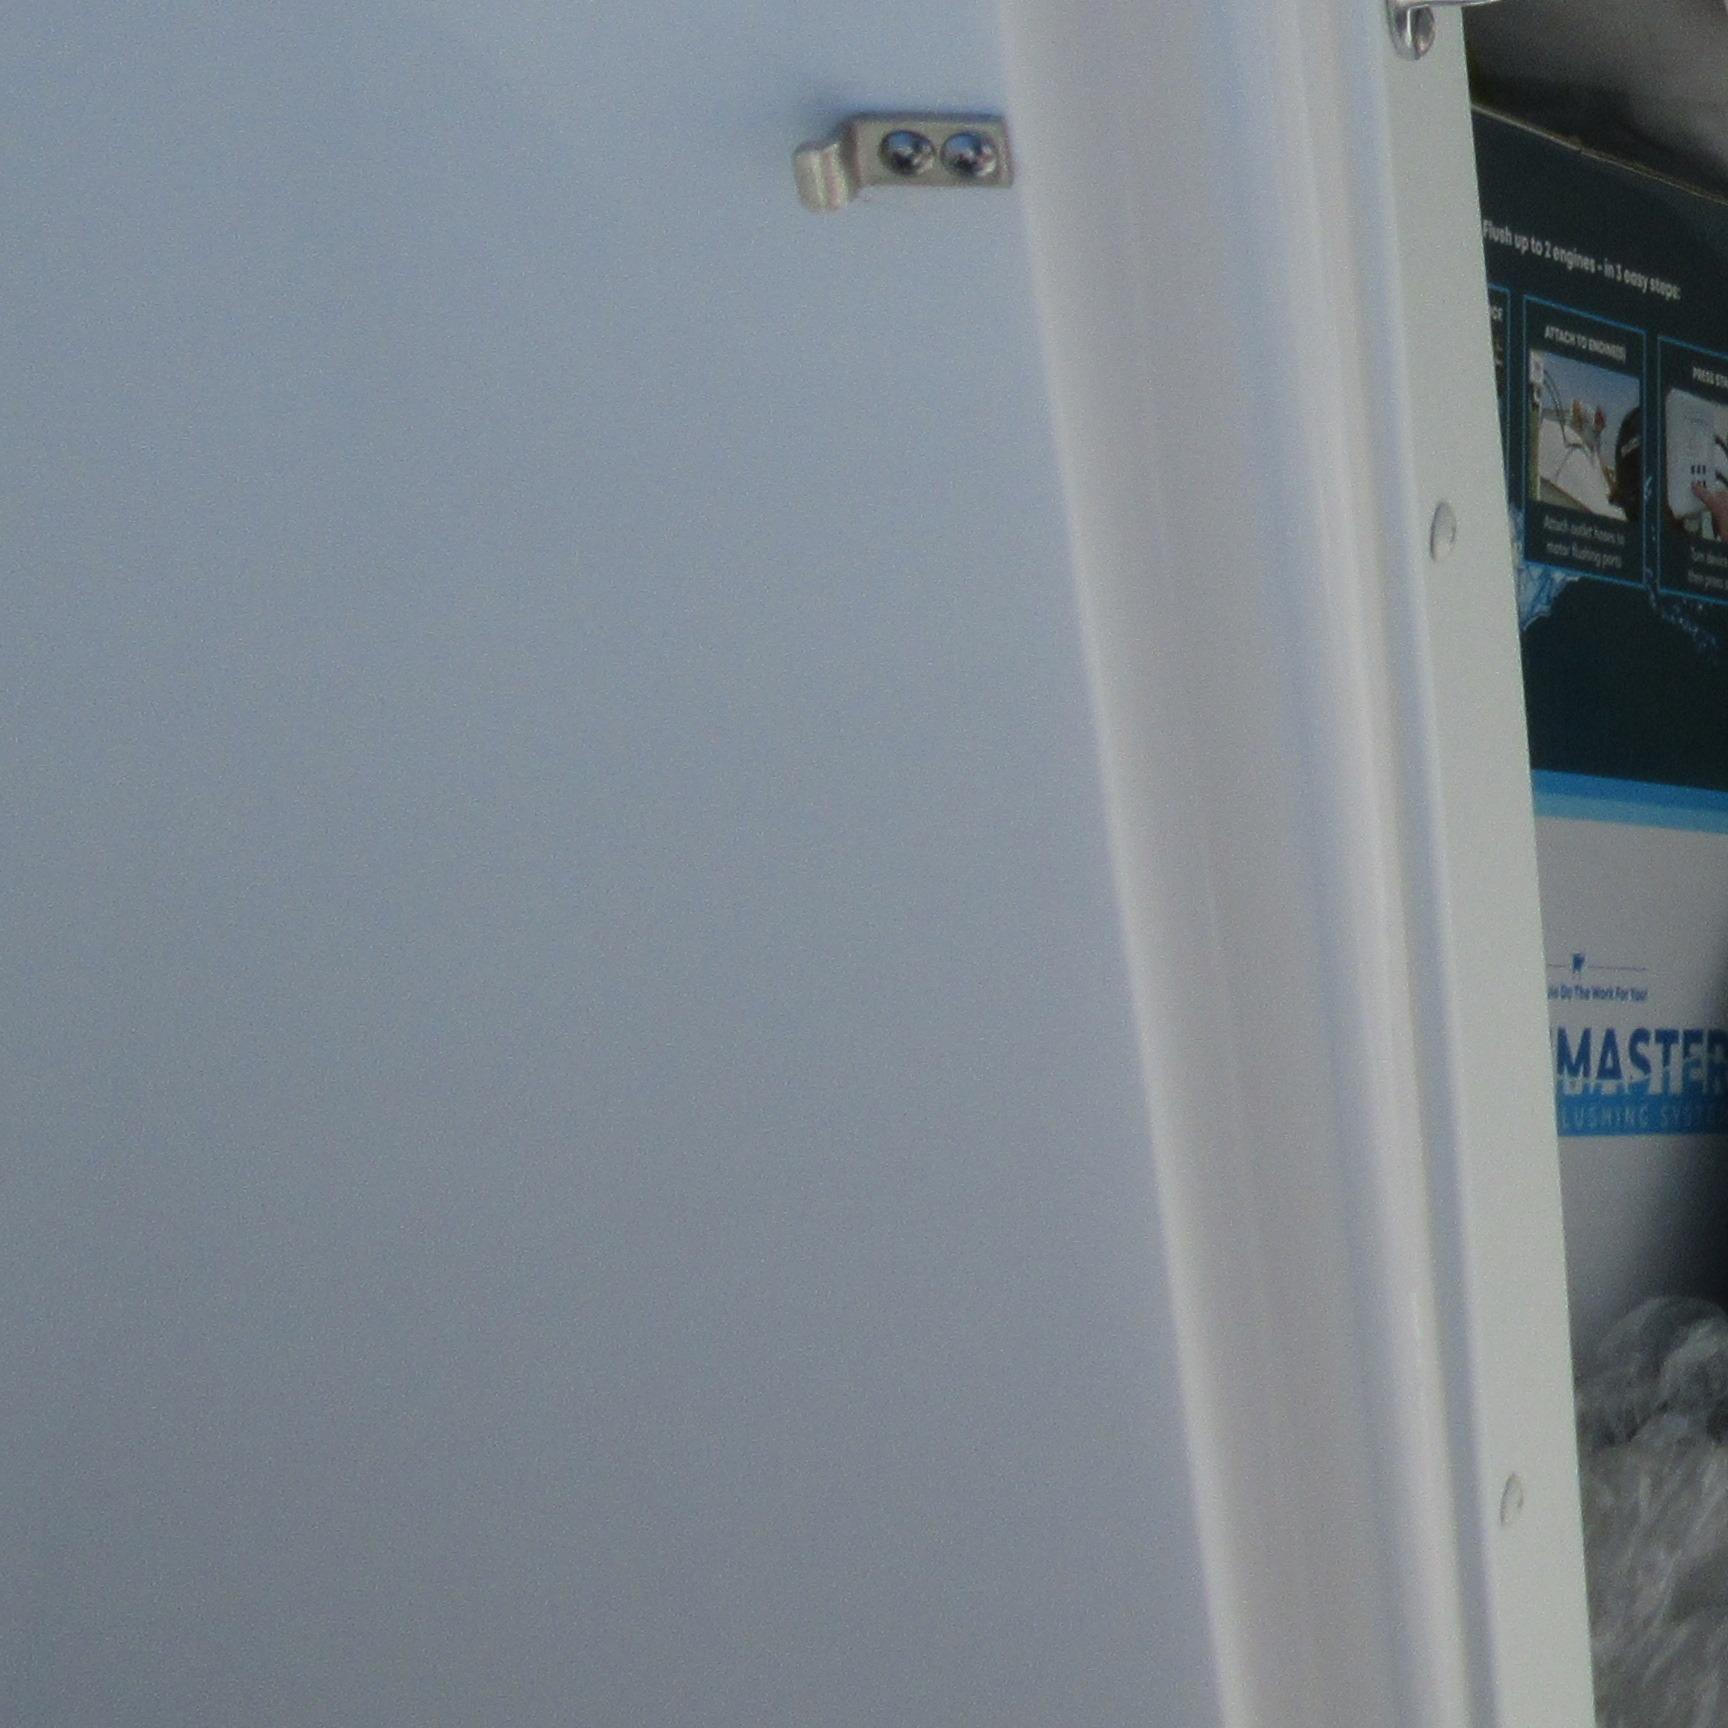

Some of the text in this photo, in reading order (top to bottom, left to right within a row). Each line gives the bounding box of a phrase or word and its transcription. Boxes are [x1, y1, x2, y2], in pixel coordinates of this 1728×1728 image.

[1482, 219, 1512, 246] Flush
[1514, 234, 1528, 254] up
[1531, 237, 1543, 256] to
[1545, 241, 1551, 259] 2
[1553, 245, 1596, 273] engines
[1604, 258, 1615, 280] in
[1624, 268, 1648, 293] easy
[1560, 1103, 1650, 1130] LUSHING
